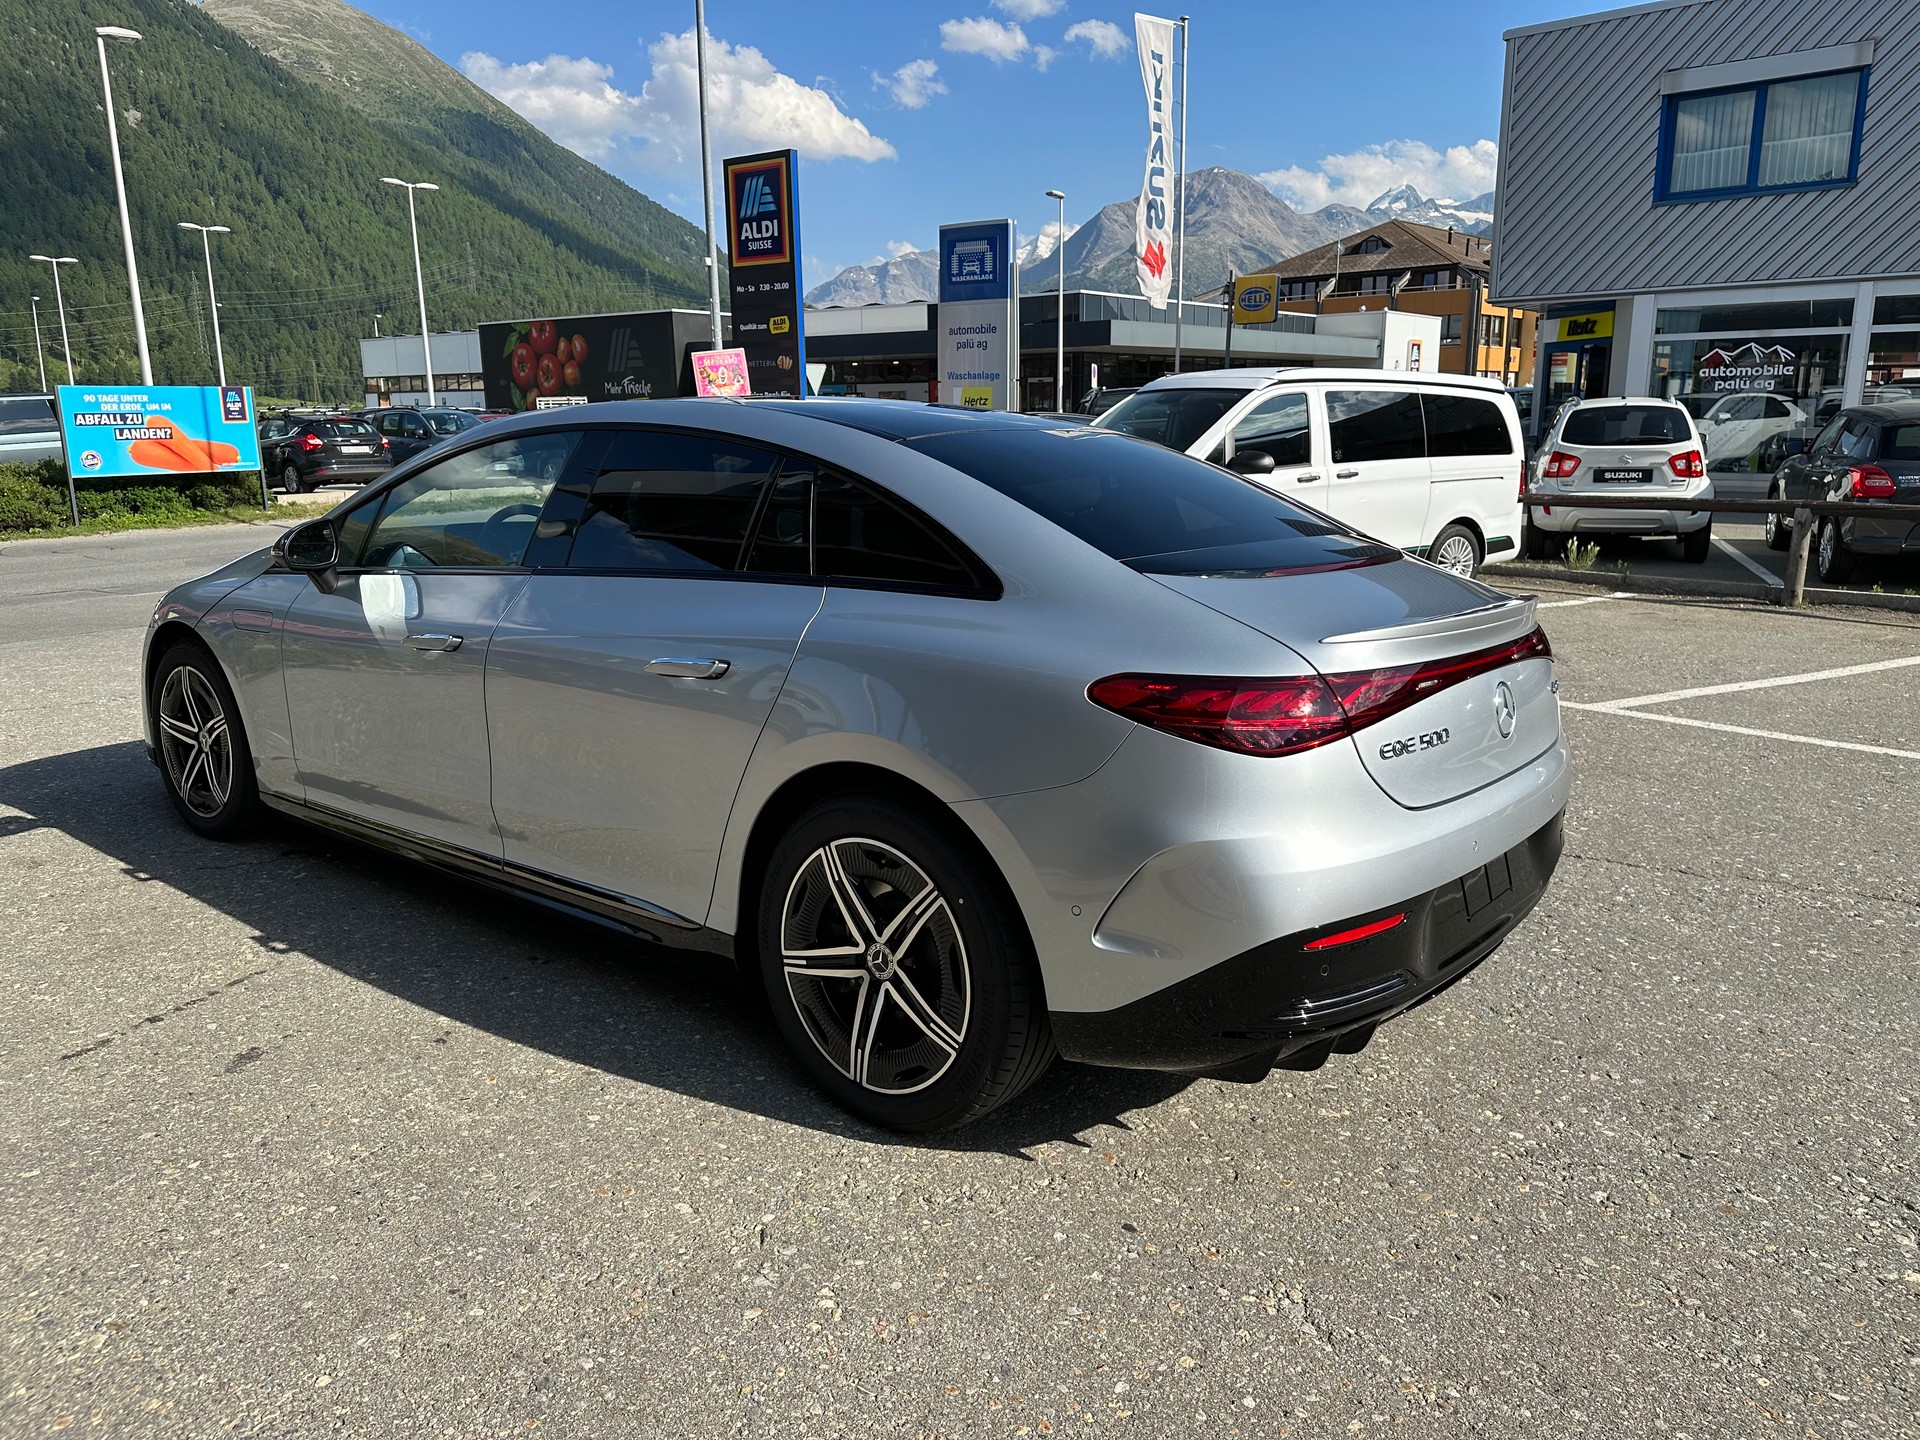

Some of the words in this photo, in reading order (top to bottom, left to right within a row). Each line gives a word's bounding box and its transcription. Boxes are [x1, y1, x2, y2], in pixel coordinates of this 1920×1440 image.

[740, 219, 778, 240] ALDI
[748, 240, 773, 250] SUISSE
[951, 273, 993, 282] WASCHANLAGE
[736, 285, 744, 293] Mo
[748, 284, 755, 292] Sa
[774, 282, 790, 290] 20.00
[1240, 293, 1271, 304] HELLA
[773, 318, 786, 326] ALDI
[1567, 318, 1597, 336] Hertz
[948, 323, 997, 336] automobile
[956, 338, 974, 351] palü
[976, 339, 987, 350] ag
[947, 370, 1000, 381] Waschanlage
[1699, 364, 1794, 377] automobile
[604, 381, 623, 395] Mehr
[622, 375, 653, 397] Frische
[1714, 377, 1750, 391] palü
[1753, 379, 1775, 391] ag
[83, 394, 96, 402] 90
[97, 394, 118, 402] TAGE
[120, 394, 149, 402] UNTER
[964, 396, 988, 407] Hertz
[101, 403, 118, 411] DER
[120, 403, 144, 411] ERDE,
[75, 413, 124, 425] ABFALL
[125, 413, 142, 425] ZU
[115, 428, 172, 440] LANDEN?
[1604, 471, 1642, 479] SUZUKI
[1379, 736, 1417, 760] EQE
[1419, 727, 1450, 751] 500
